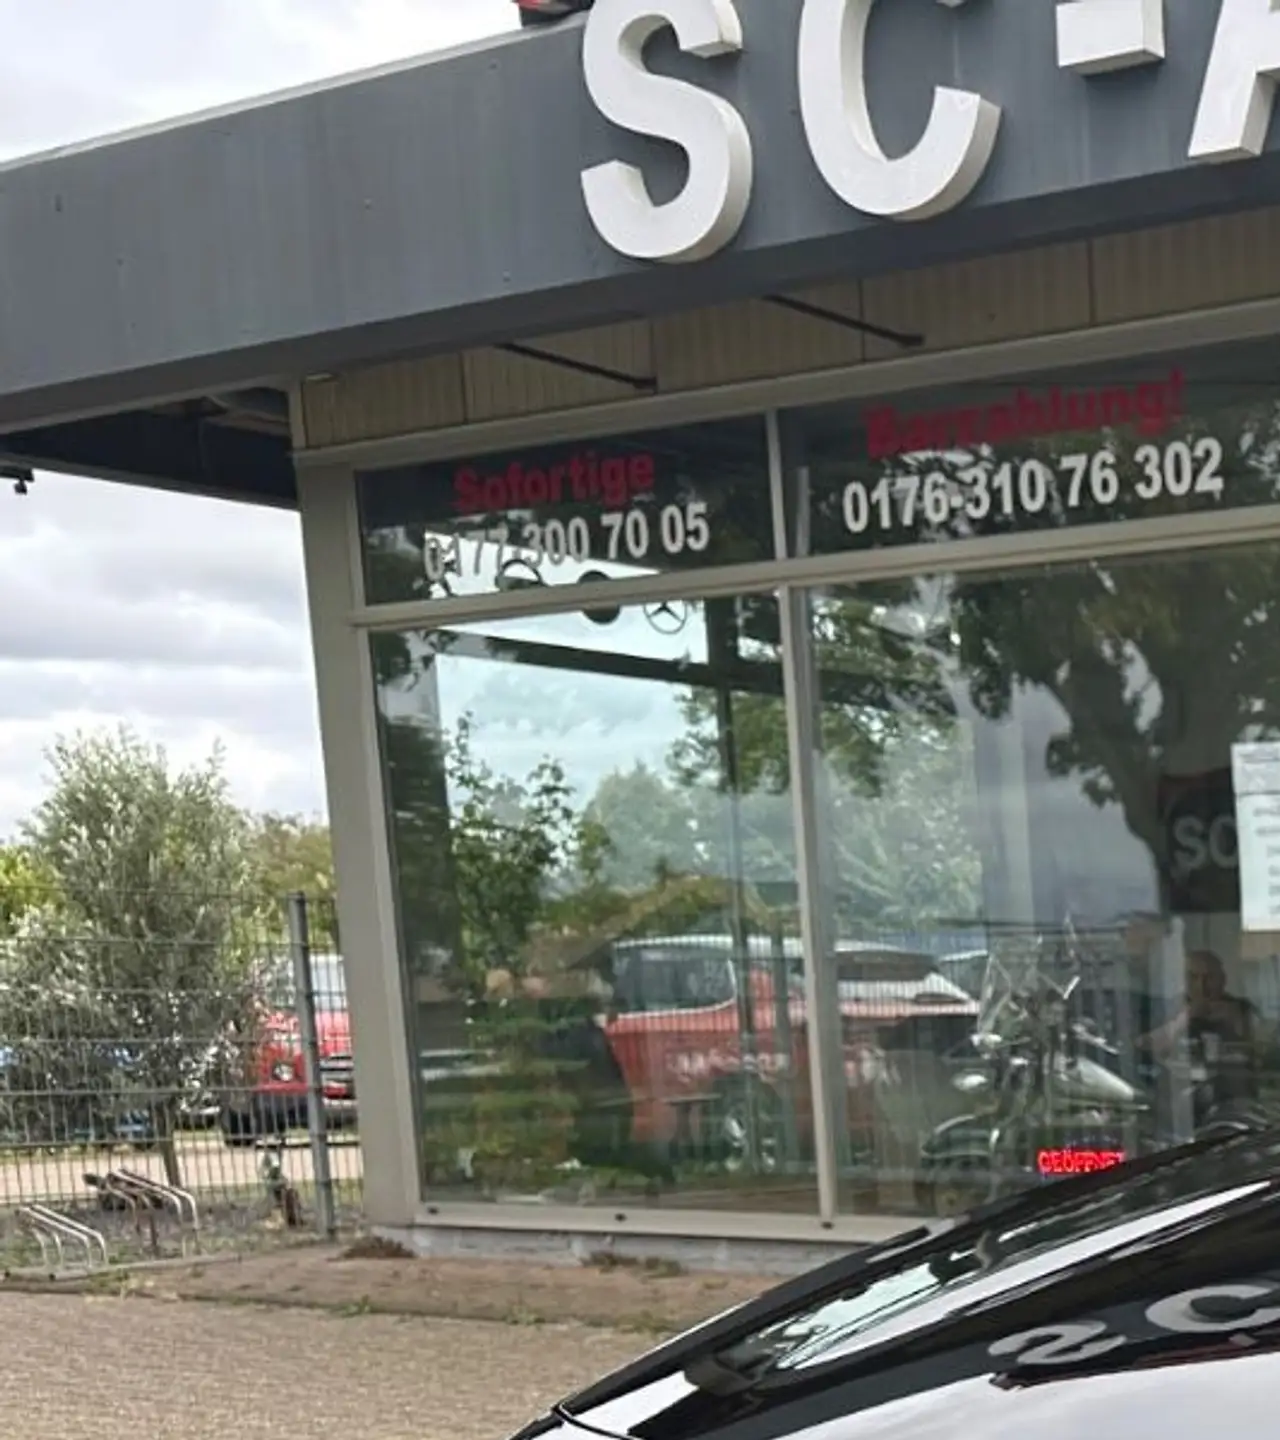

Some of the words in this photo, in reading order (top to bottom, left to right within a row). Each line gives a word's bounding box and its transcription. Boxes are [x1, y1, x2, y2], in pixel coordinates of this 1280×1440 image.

[454, 452, 655, 513] Sofortige
[842, 459, 1047, 533] 0176-310
[1059, 450, 1120, 507] 76
[1134, 437, 1224, 500] 302
[601, 511, 649, 560] 70
[660, 502, 710, 554] 05
